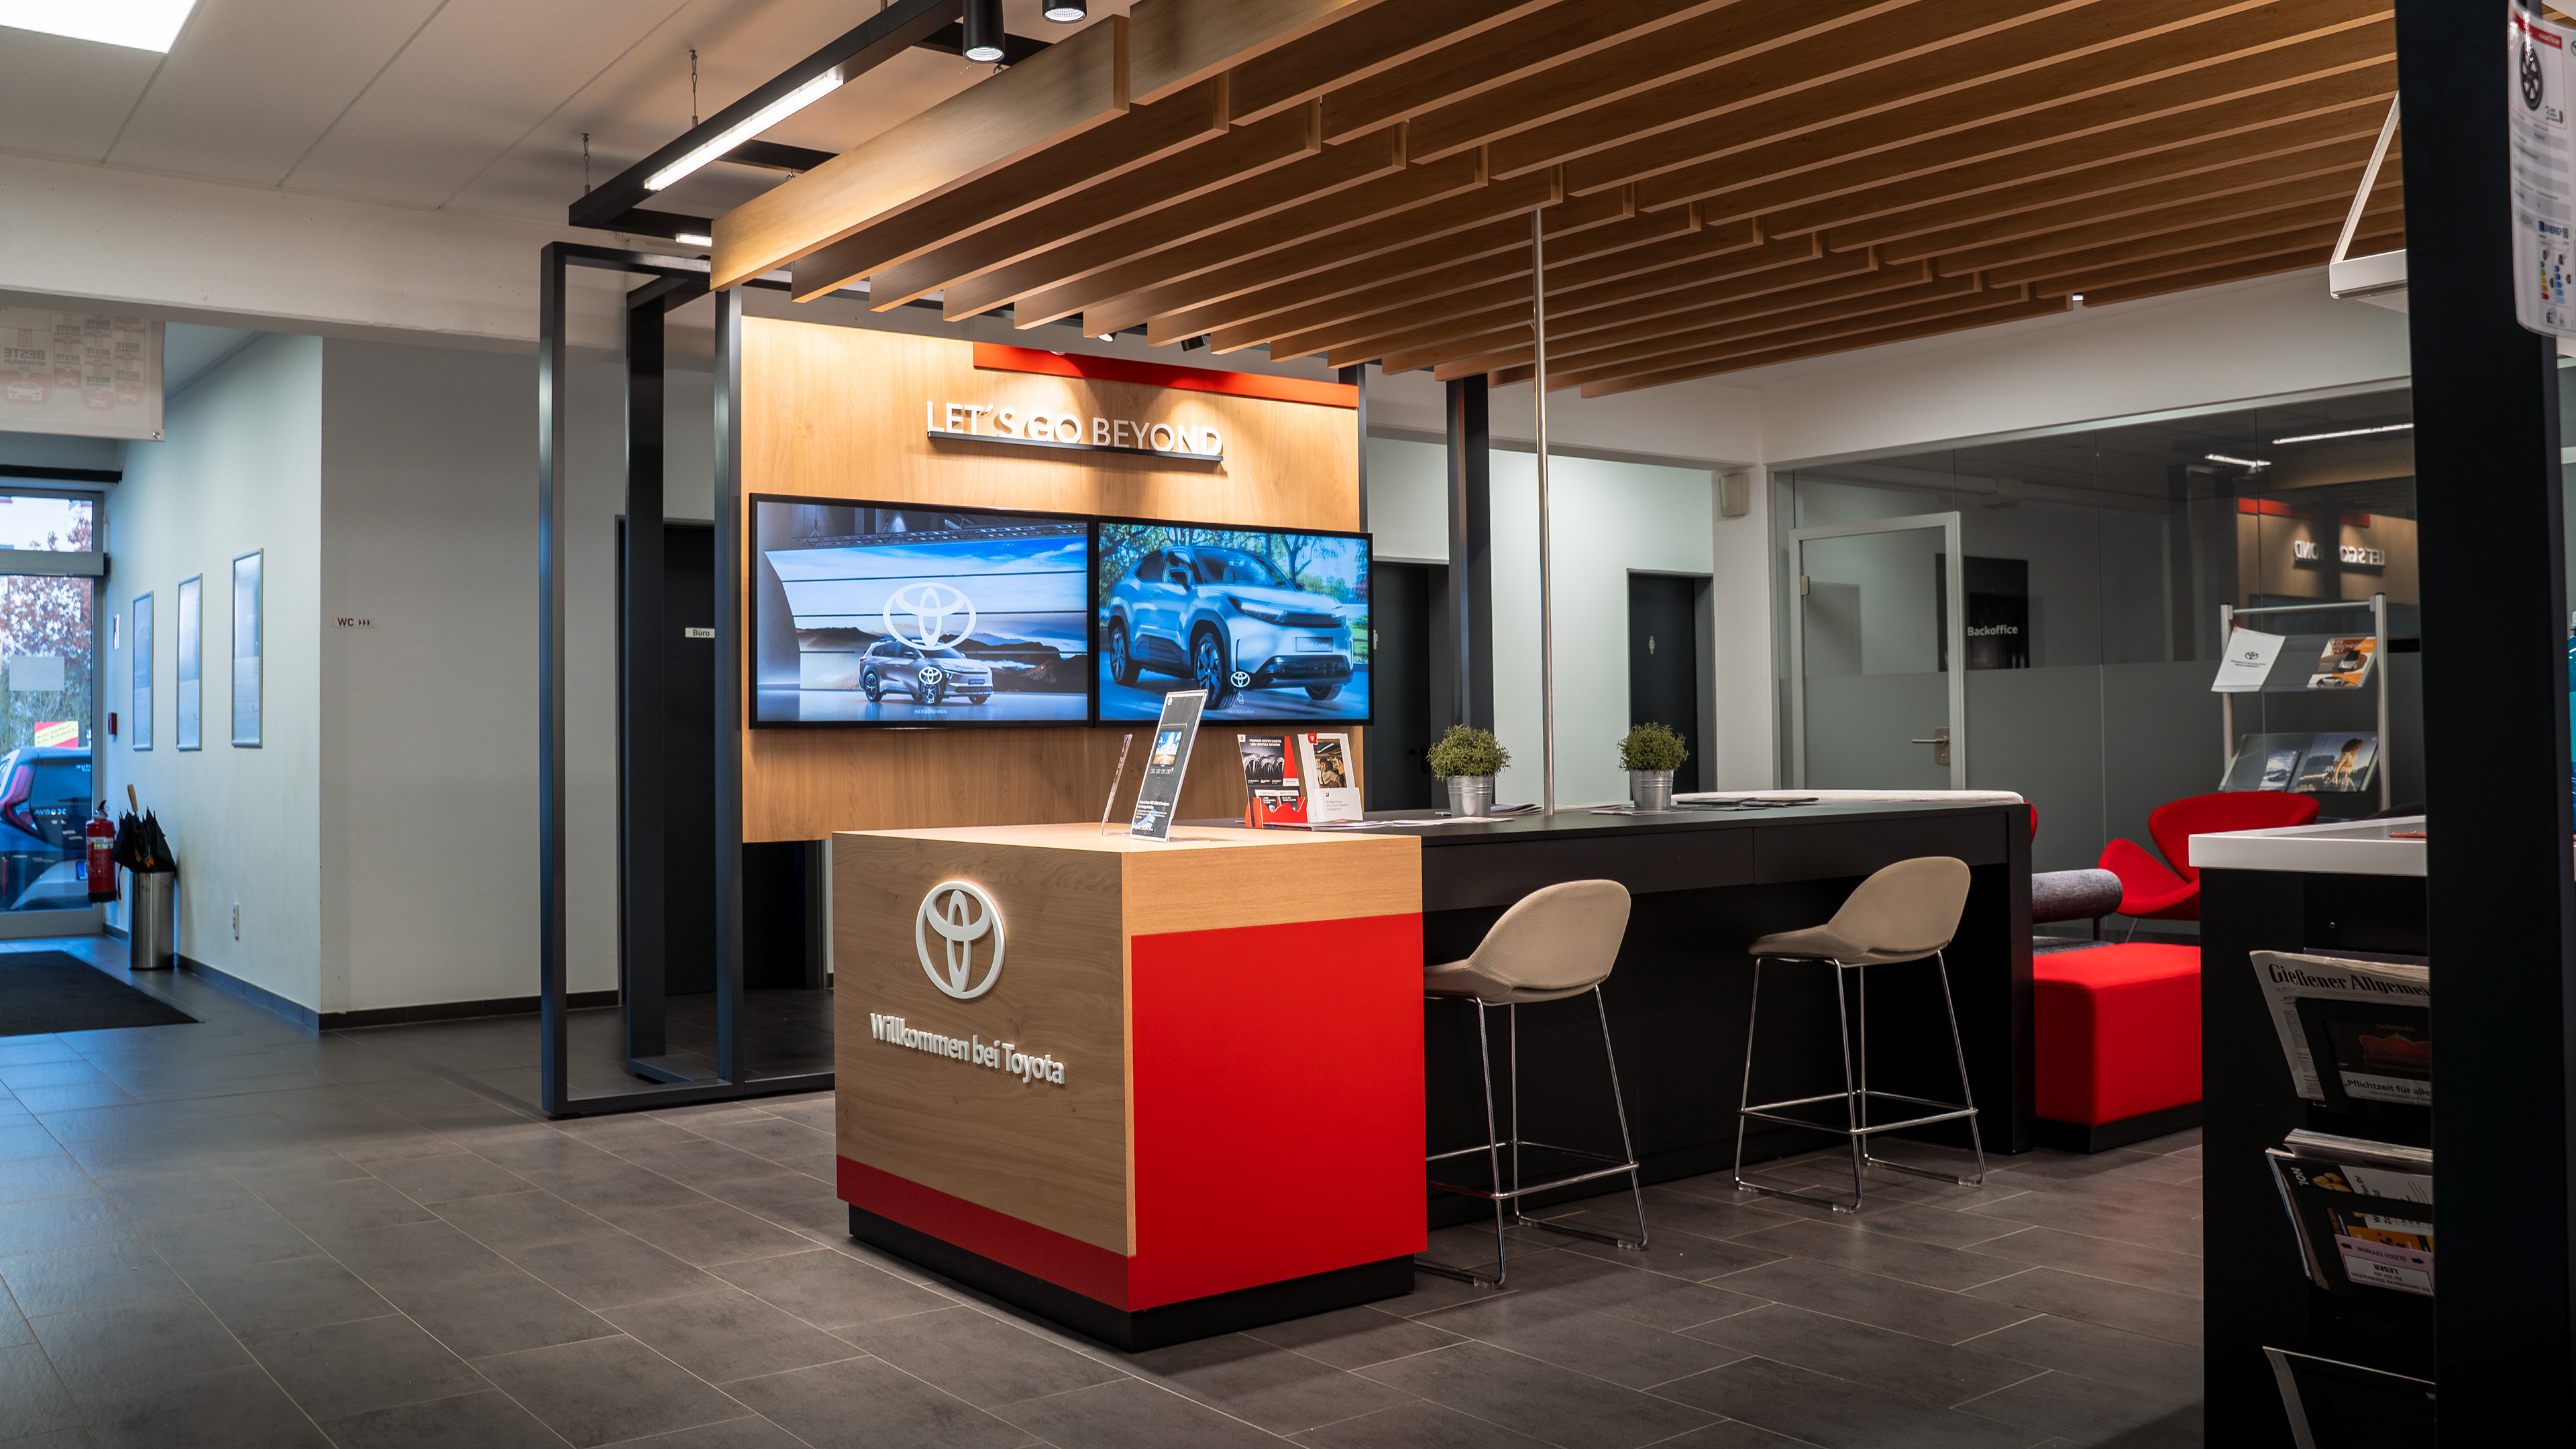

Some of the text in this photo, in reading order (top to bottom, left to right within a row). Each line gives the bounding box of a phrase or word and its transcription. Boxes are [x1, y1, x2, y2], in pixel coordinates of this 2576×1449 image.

[1026, 411, 1083, 444] GO
[1092, 417, 1223, 456] BEYOND
[337, 617, 354, 627] WC
[692, 628, 710, 637] Büro
[1968, 625, 2019, 637] Backoffice
[2268, 963, 2429, 998] Gießener Allgemei
[869, 1012, 1065, 1085] Willkommen bei Toyota
[2396, 1084, 2411, 1094] für
[2385, 1252, 2407, 1262] GLEICH
[2373, 1263, 2398, 1275] LESER
